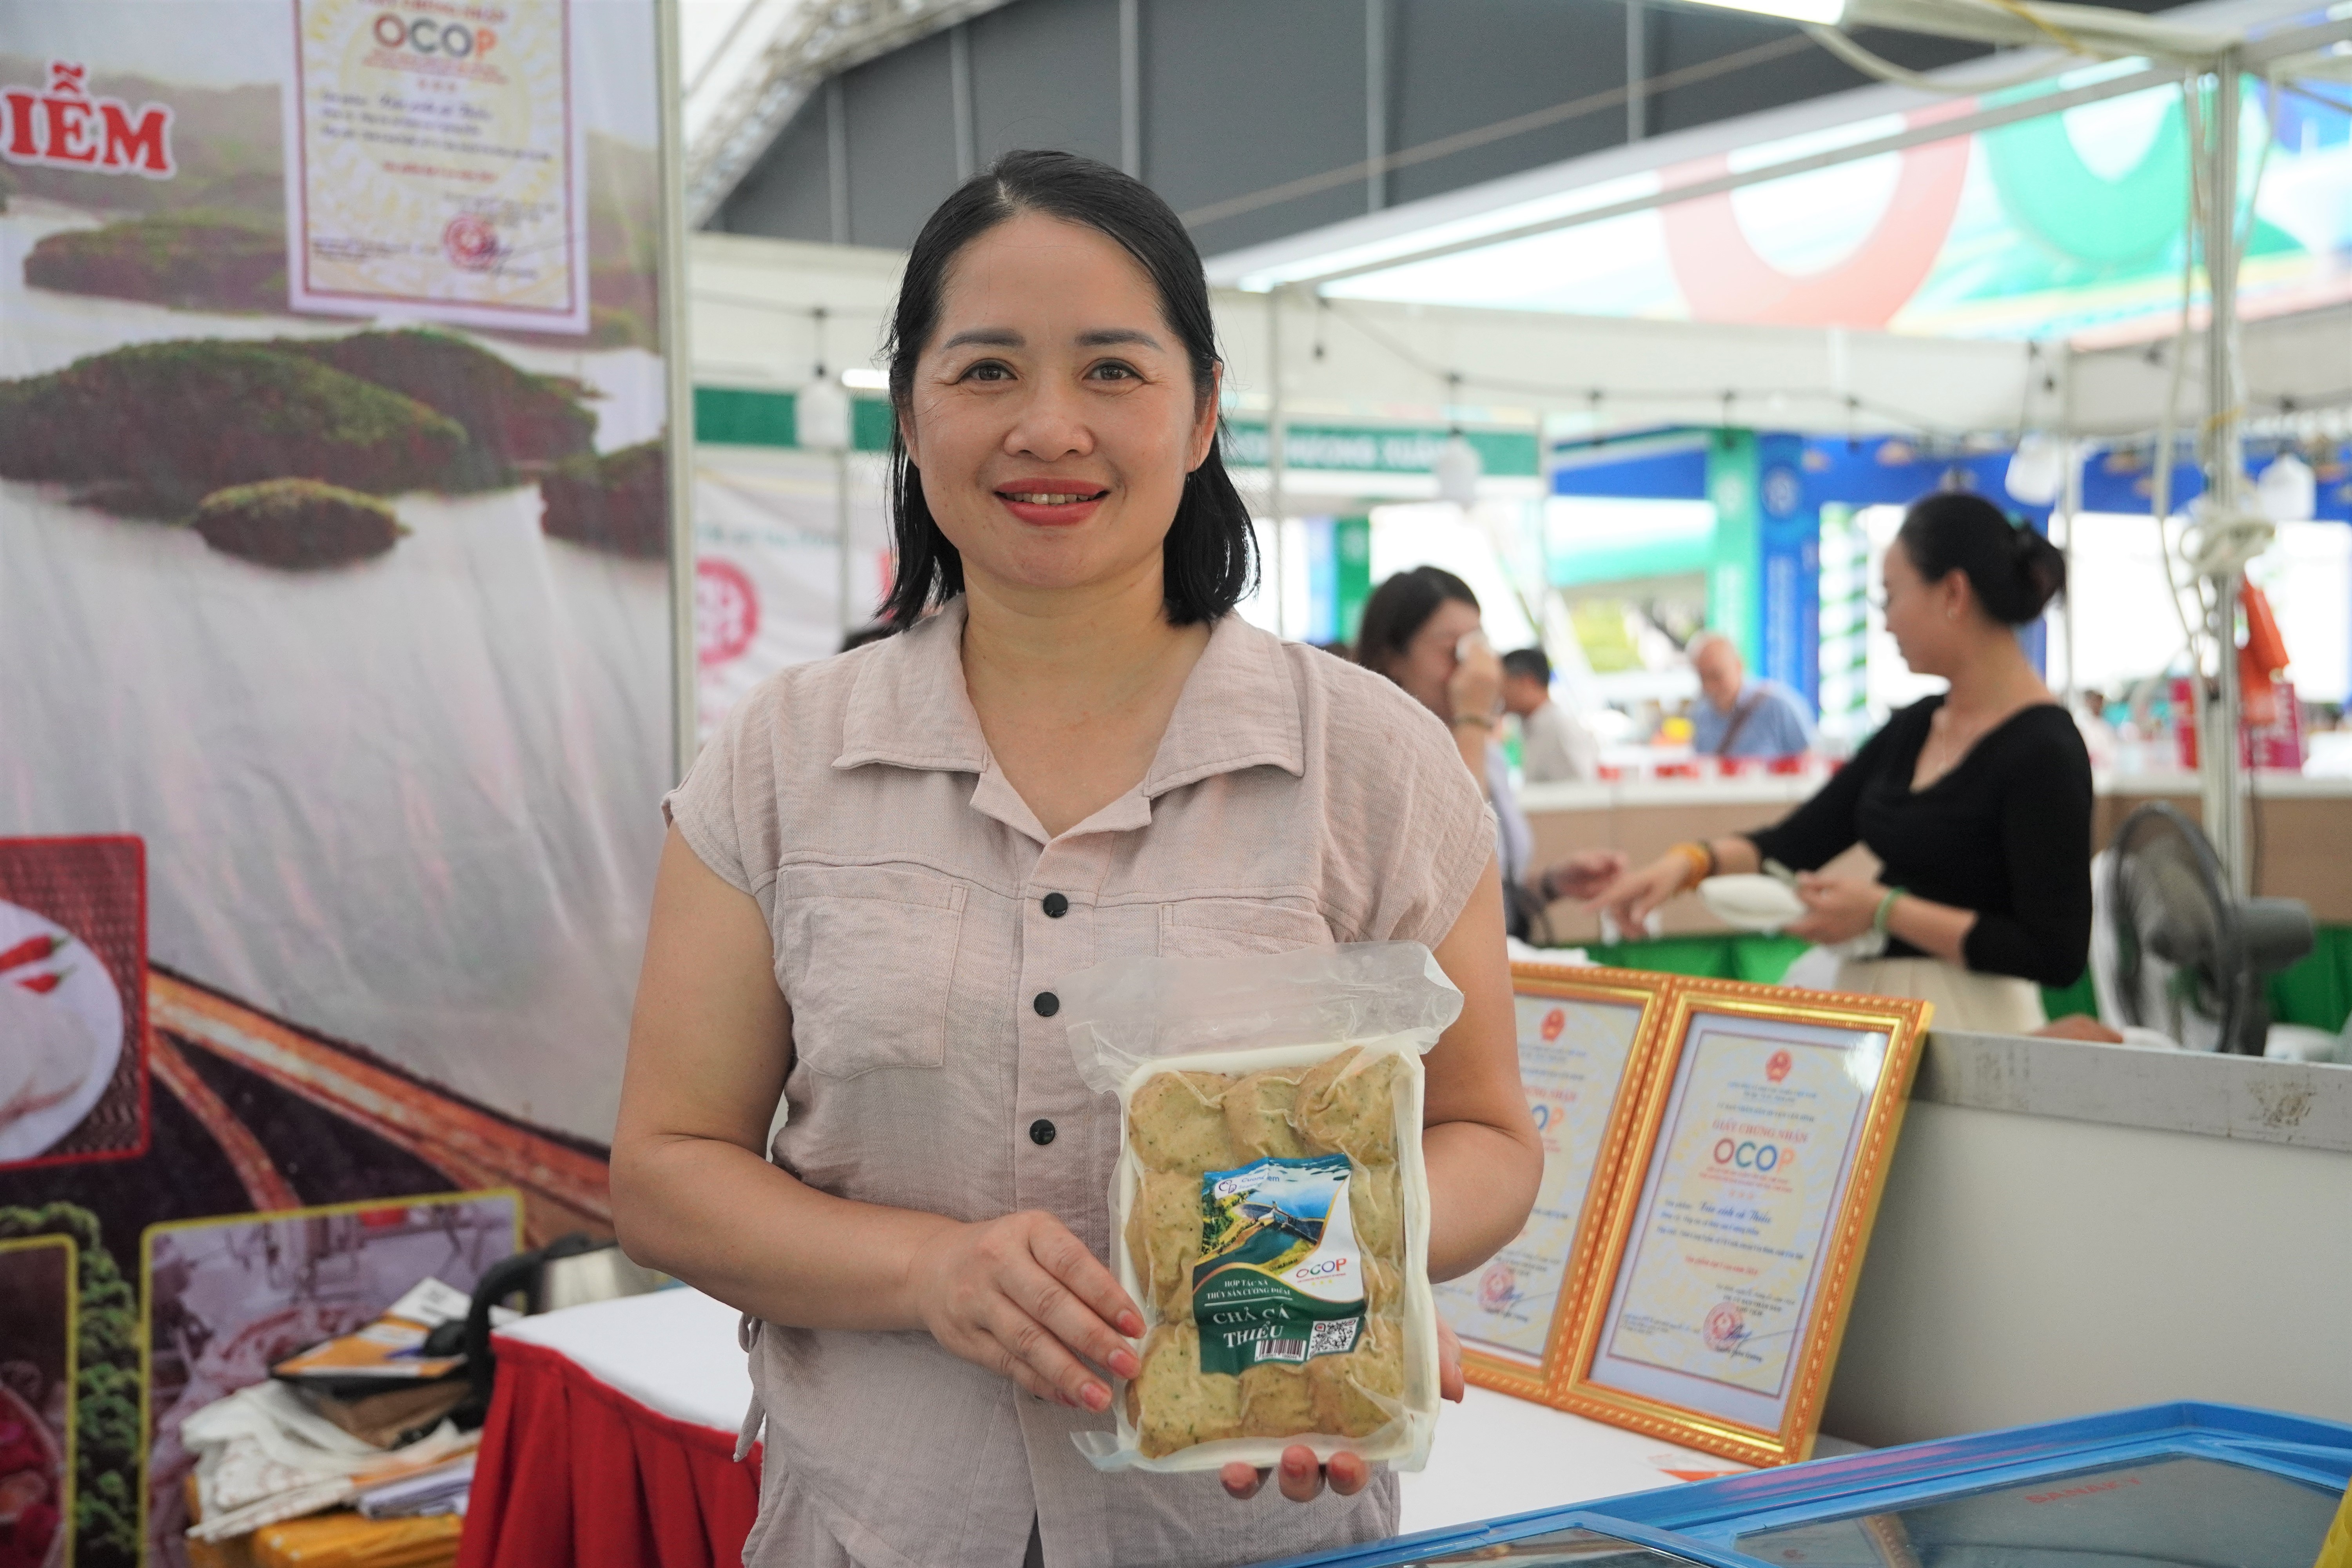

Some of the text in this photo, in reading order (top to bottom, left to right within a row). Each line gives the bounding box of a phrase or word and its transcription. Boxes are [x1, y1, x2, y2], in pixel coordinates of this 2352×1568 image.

[373, 11, 497, 60] OCOP
[0, 62, 169, 173] IỄM
[1713, 1138, 1795, 1174] OCOP
[1296, 1258, 1347, 1278] OCOP
[1225, 1279, 1240, 1288] HỢP
[1241, 1278, 1256, 1287] TÁC
[1213, 1303, 1290, 1325] CHẢ CÁ
[1223, 1320, 1284, 1348] THIỂU
